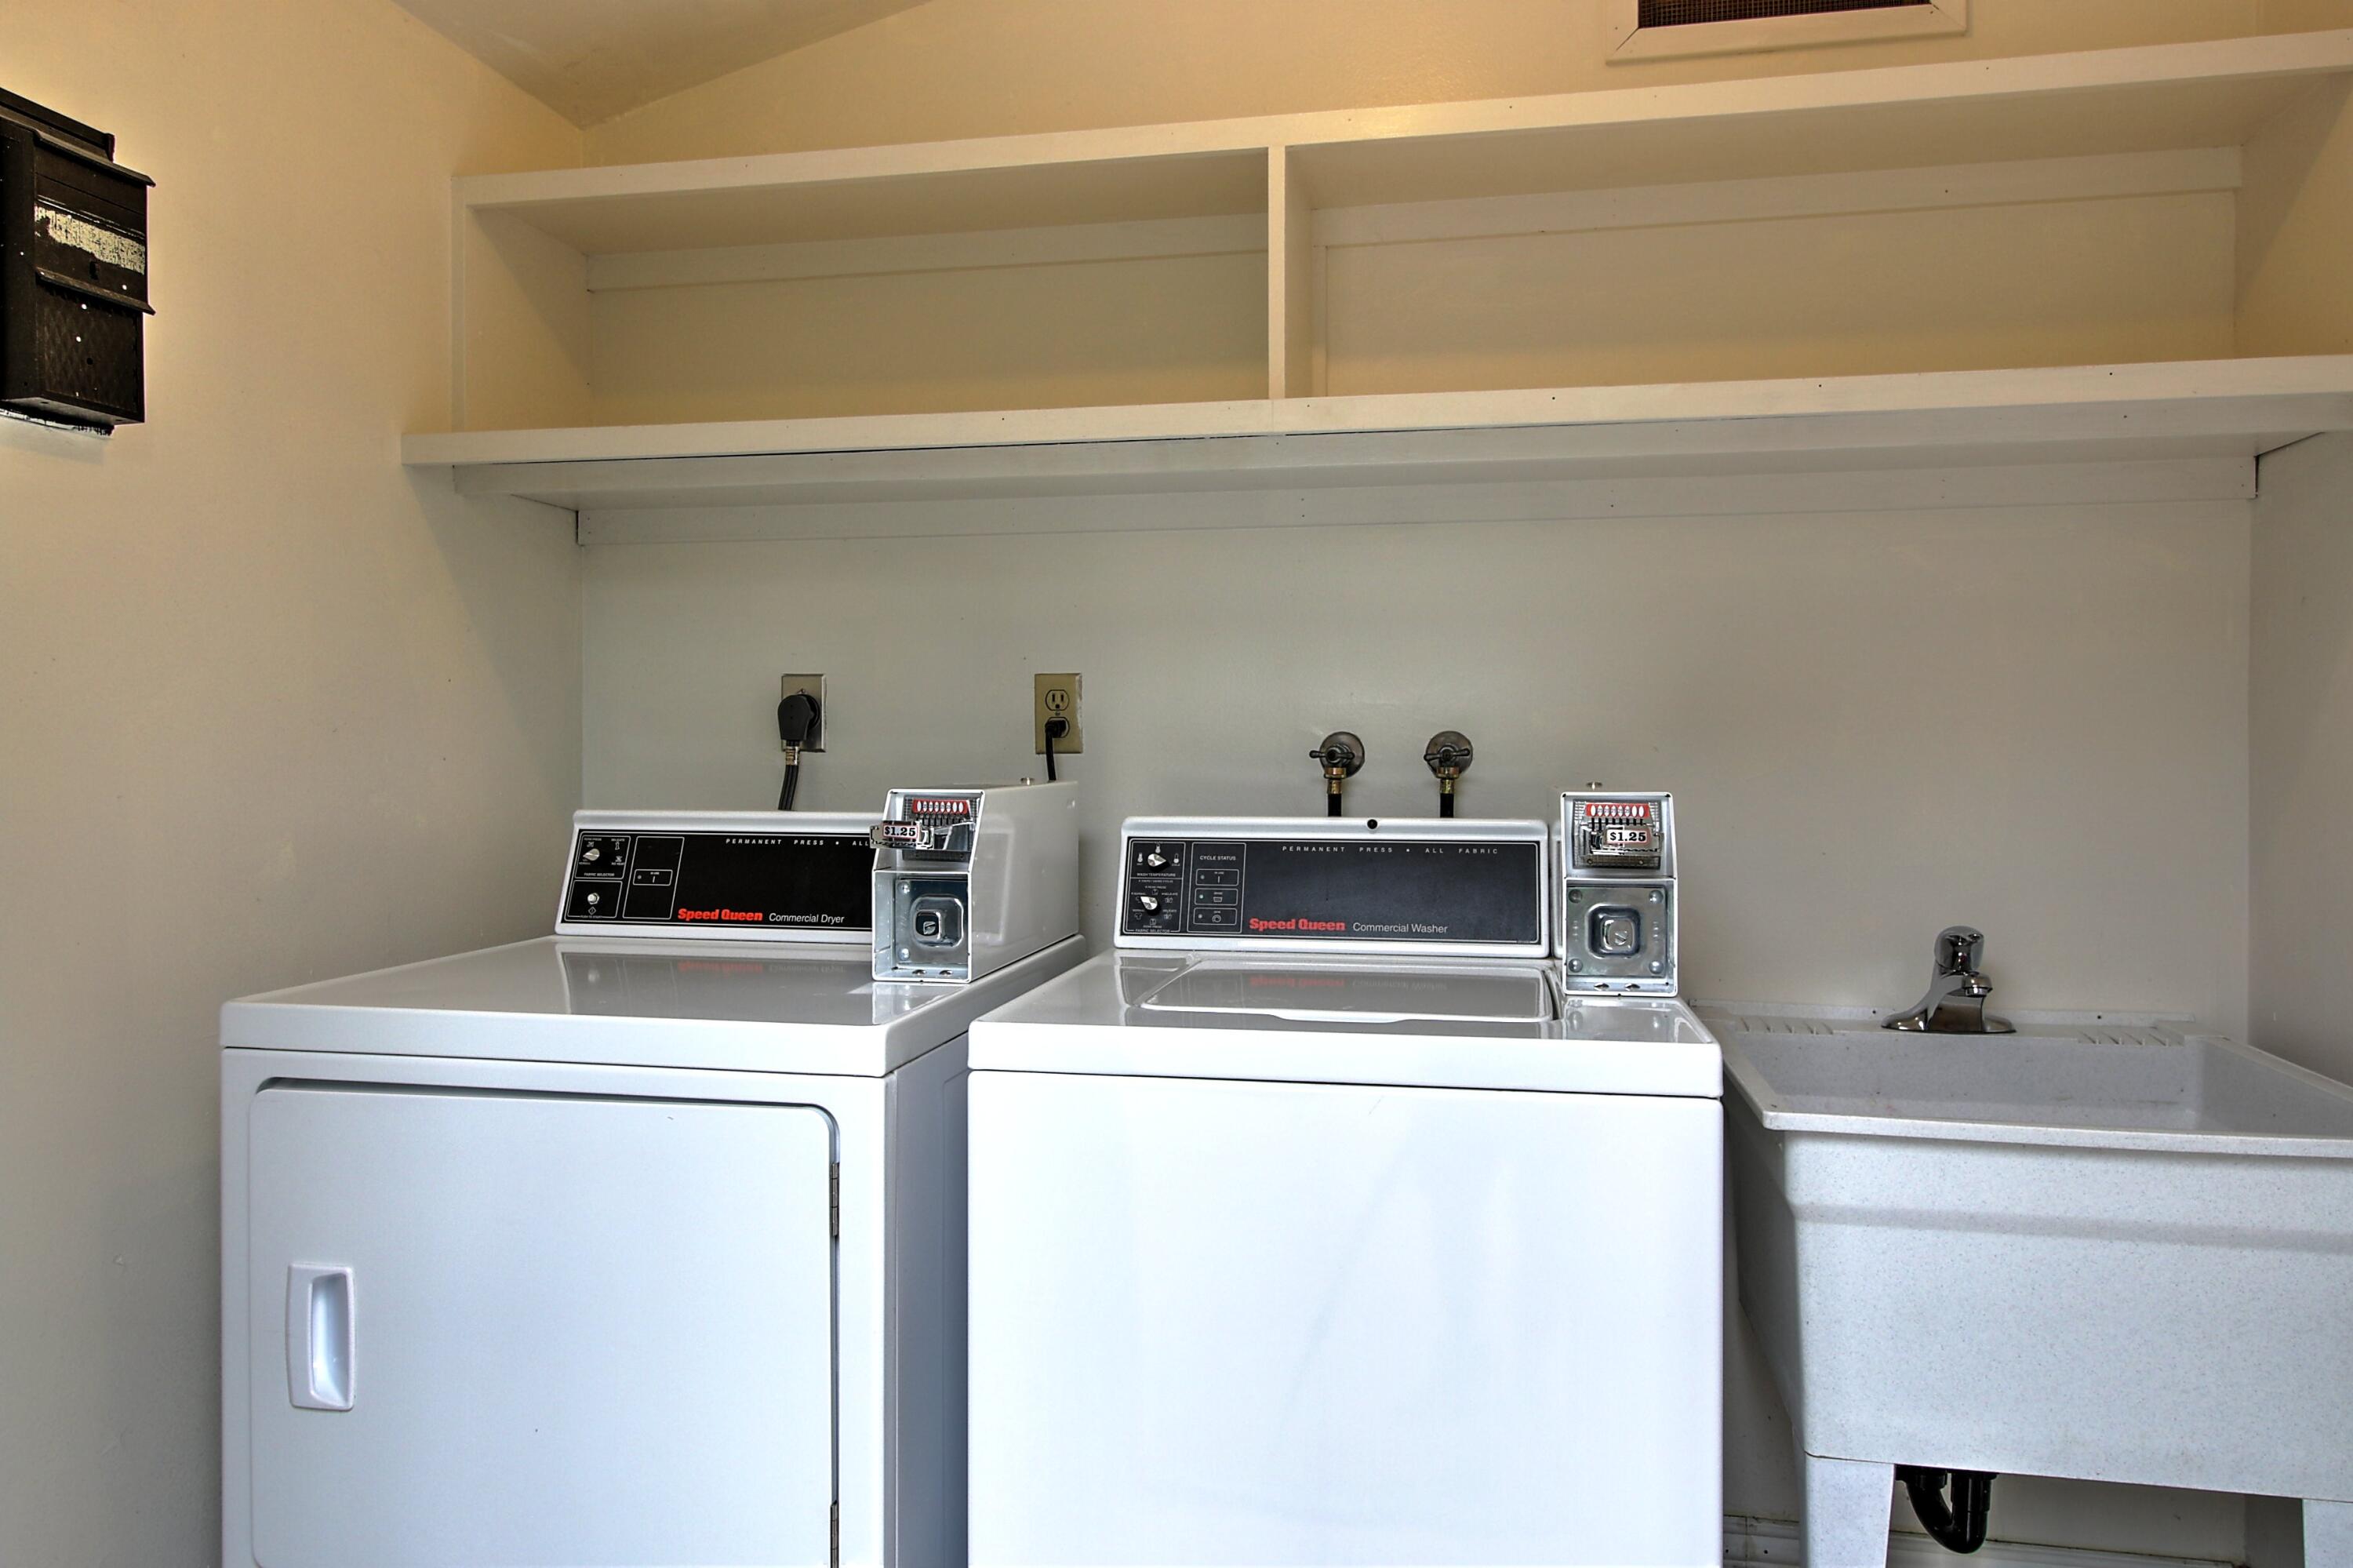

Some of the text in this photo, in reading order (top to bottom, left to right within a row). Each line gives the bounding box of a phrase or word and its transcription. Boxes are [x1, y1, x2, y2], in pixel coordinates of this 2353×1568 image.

[884, 826, 916, 837] $1.25
[1609, 831, 1646, 842] $1.25
[678, 908, 845, 925] Speed Queen Commercial Dryer
[1249, 917, 1449, 934] Speed Queen Commercial Washer
